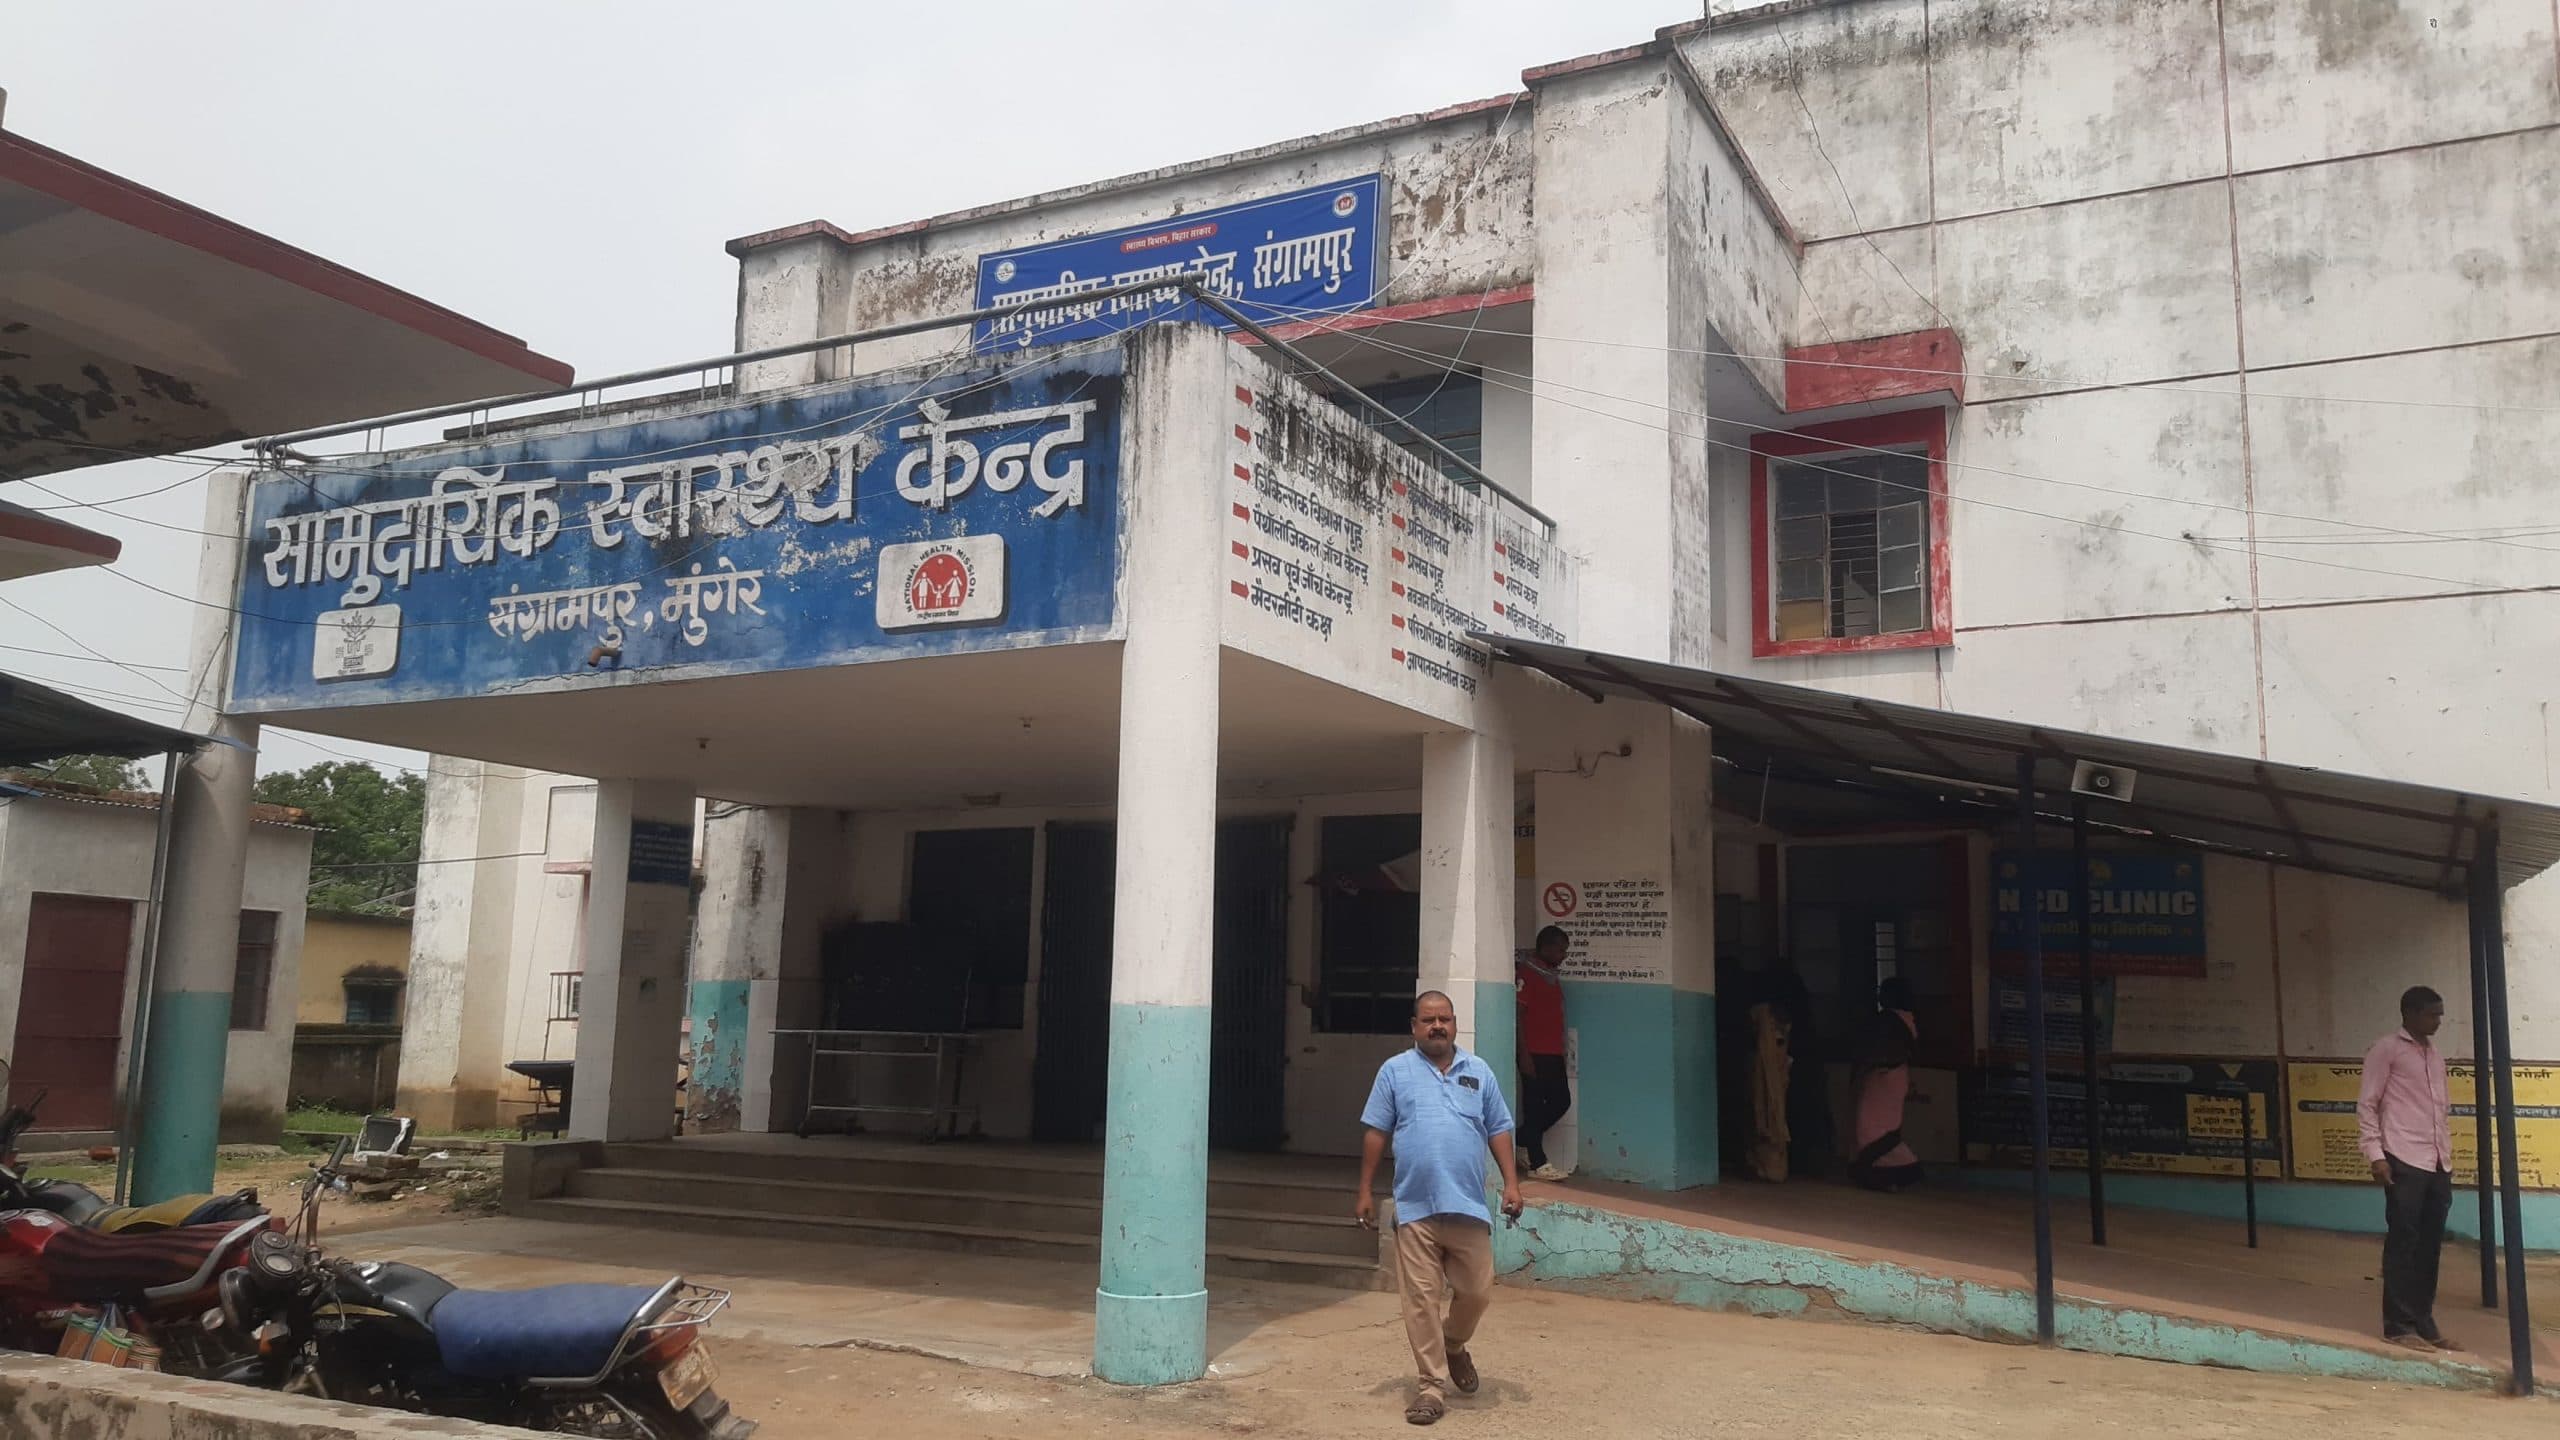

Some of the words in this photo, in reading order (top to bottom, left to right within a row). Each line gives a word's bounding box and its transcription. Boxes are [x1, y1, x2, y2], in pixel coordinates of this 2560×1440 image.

[1253, 227, 1356, 294] संग्रामपुर
[263, 465, 561, 609] सामुदायिक
[895, 398, 1097, 518] केन्द्र
[488, 583, 653, 649] संग्रामपुर,
[660, 556, 769, 647] मुंगेर
[904, 564, 919, 613] NATIONAL
[919, 544, 953, 561] HEALTH
[956, 549, 977, 598] MISSION
[1251, 545, 1282, 576] प्रसव
[1324, 573, 1354, 616] केन्द्र
[1305, 607, 1333, 643] कक्ष
